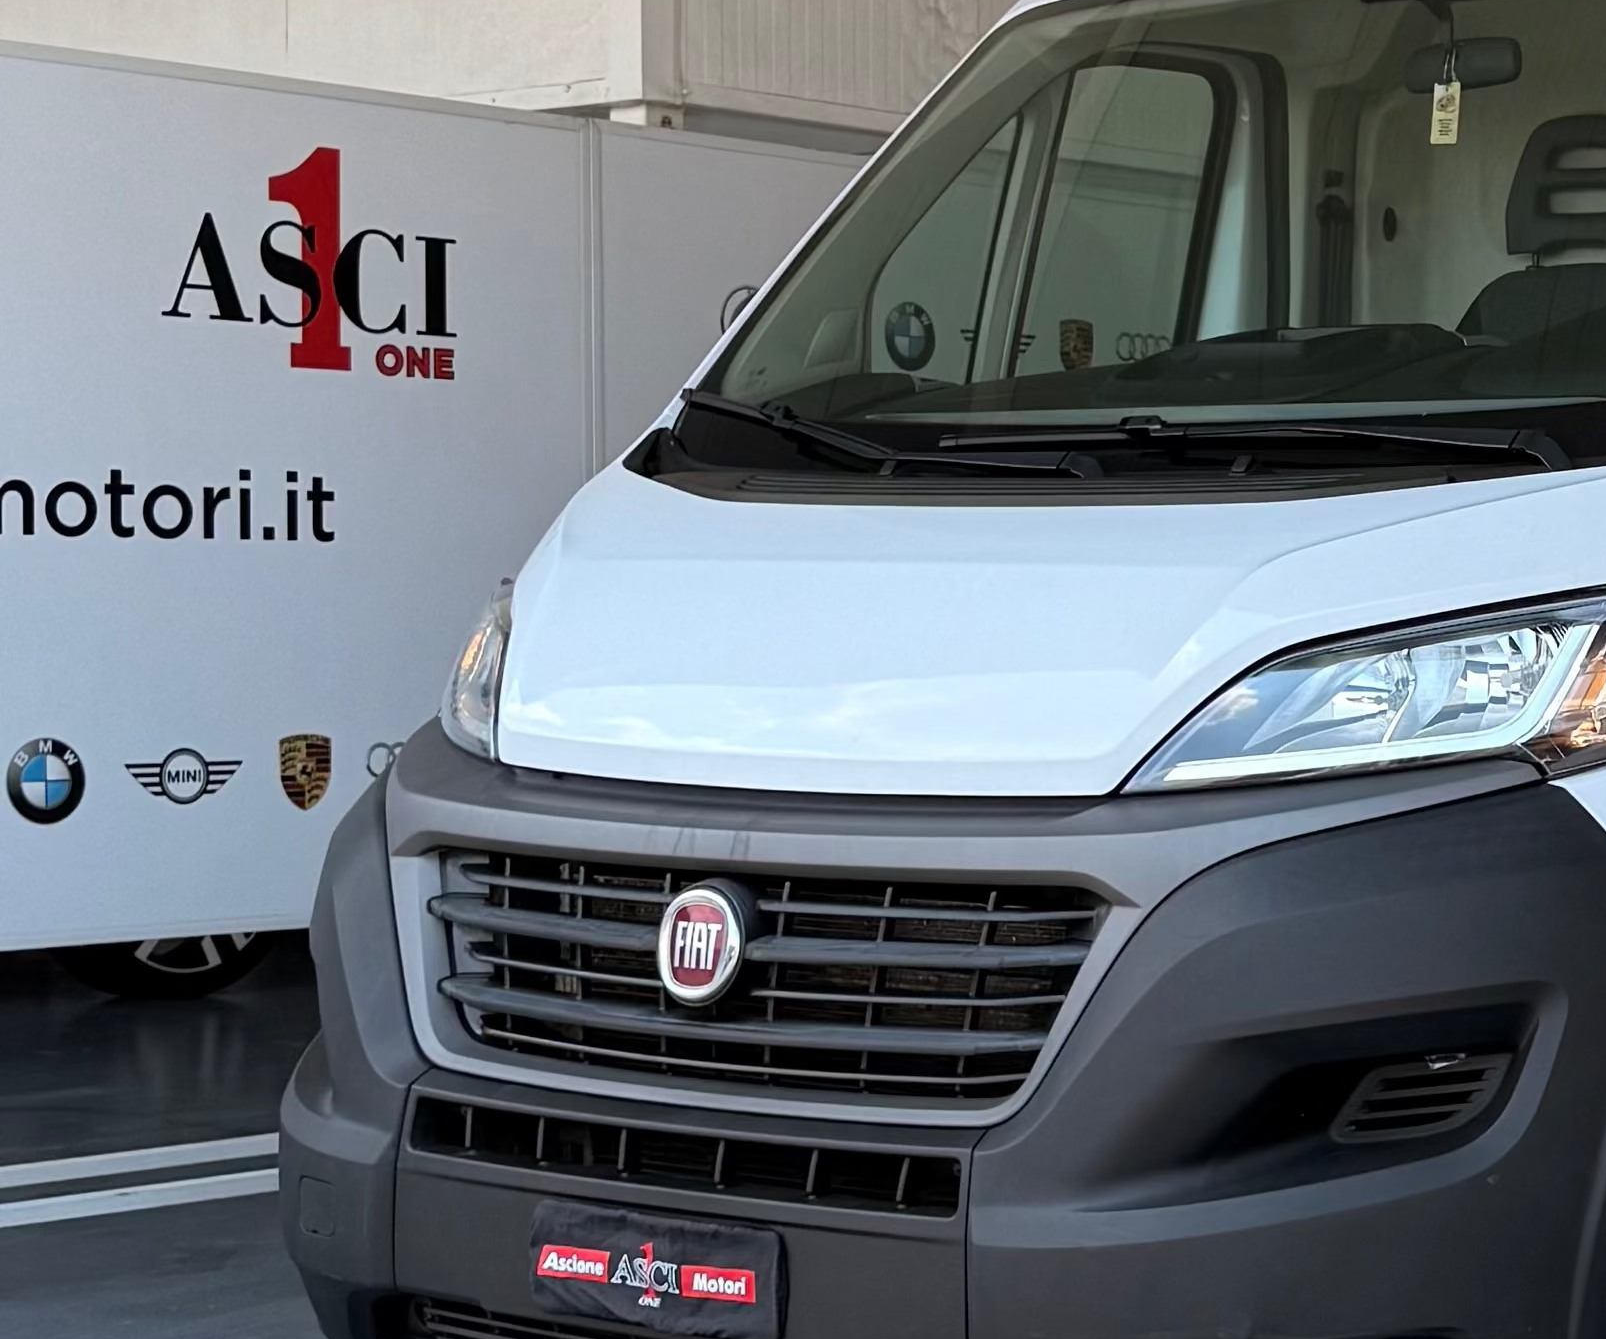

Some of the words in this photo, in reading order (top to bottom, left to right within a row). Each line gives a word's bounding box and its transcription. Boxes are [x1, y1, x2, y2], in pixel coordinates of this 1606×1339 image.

[161, 211, 458, 338] ASCI
[375, 344, 455, 380] ONE
[13, 739, 79, 768] BMW
[166, 768, 203, 785] MINI
[673, 920, 723, 971] FIAT
[542, 1251, 605, 1277] Ascione
[610, 1253, 681, 1295] ASCI
[692, 1272, 747, 1296] Motori
